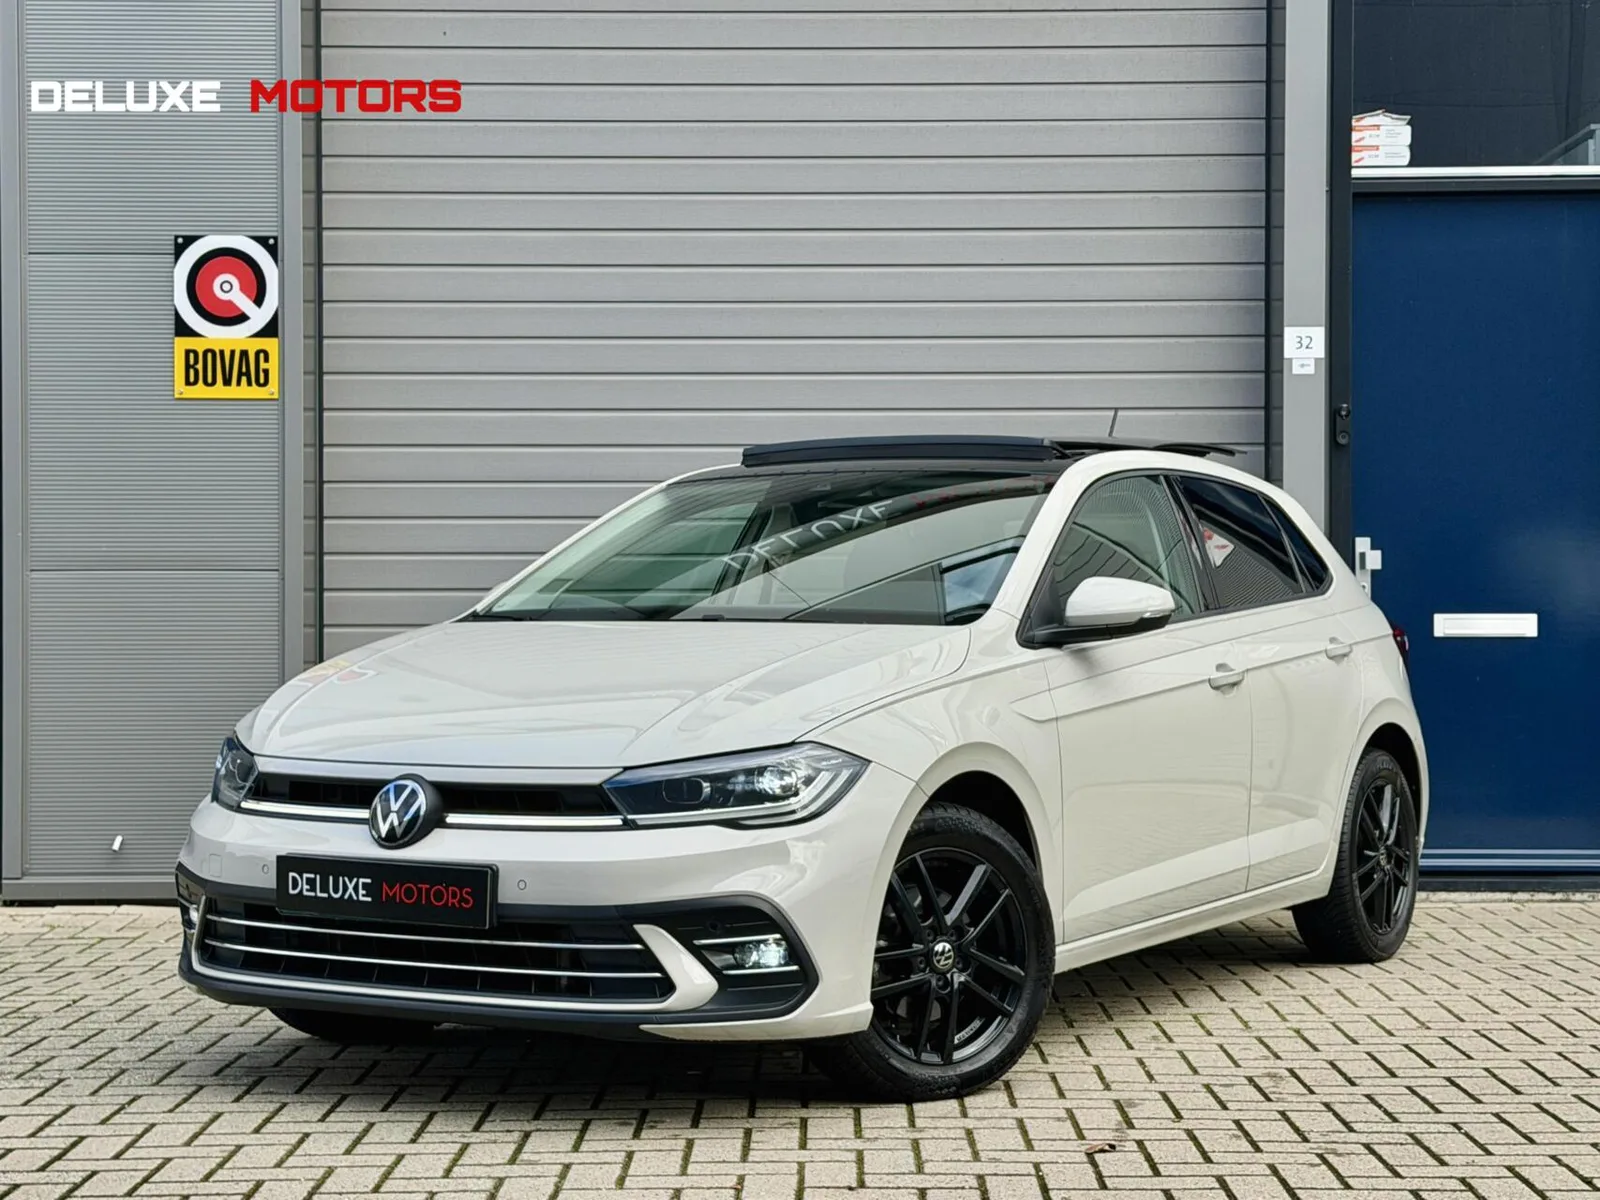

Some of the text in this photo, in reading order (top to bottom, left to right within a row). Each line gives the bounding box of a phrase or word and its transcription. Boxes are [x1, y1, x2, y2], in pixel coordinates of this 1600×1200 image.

[1295, 335, 1313, 350] 32
[183, 348, 270, 388] BOVAG
[288, 871, 473, 908] DELUXE MOTORS
